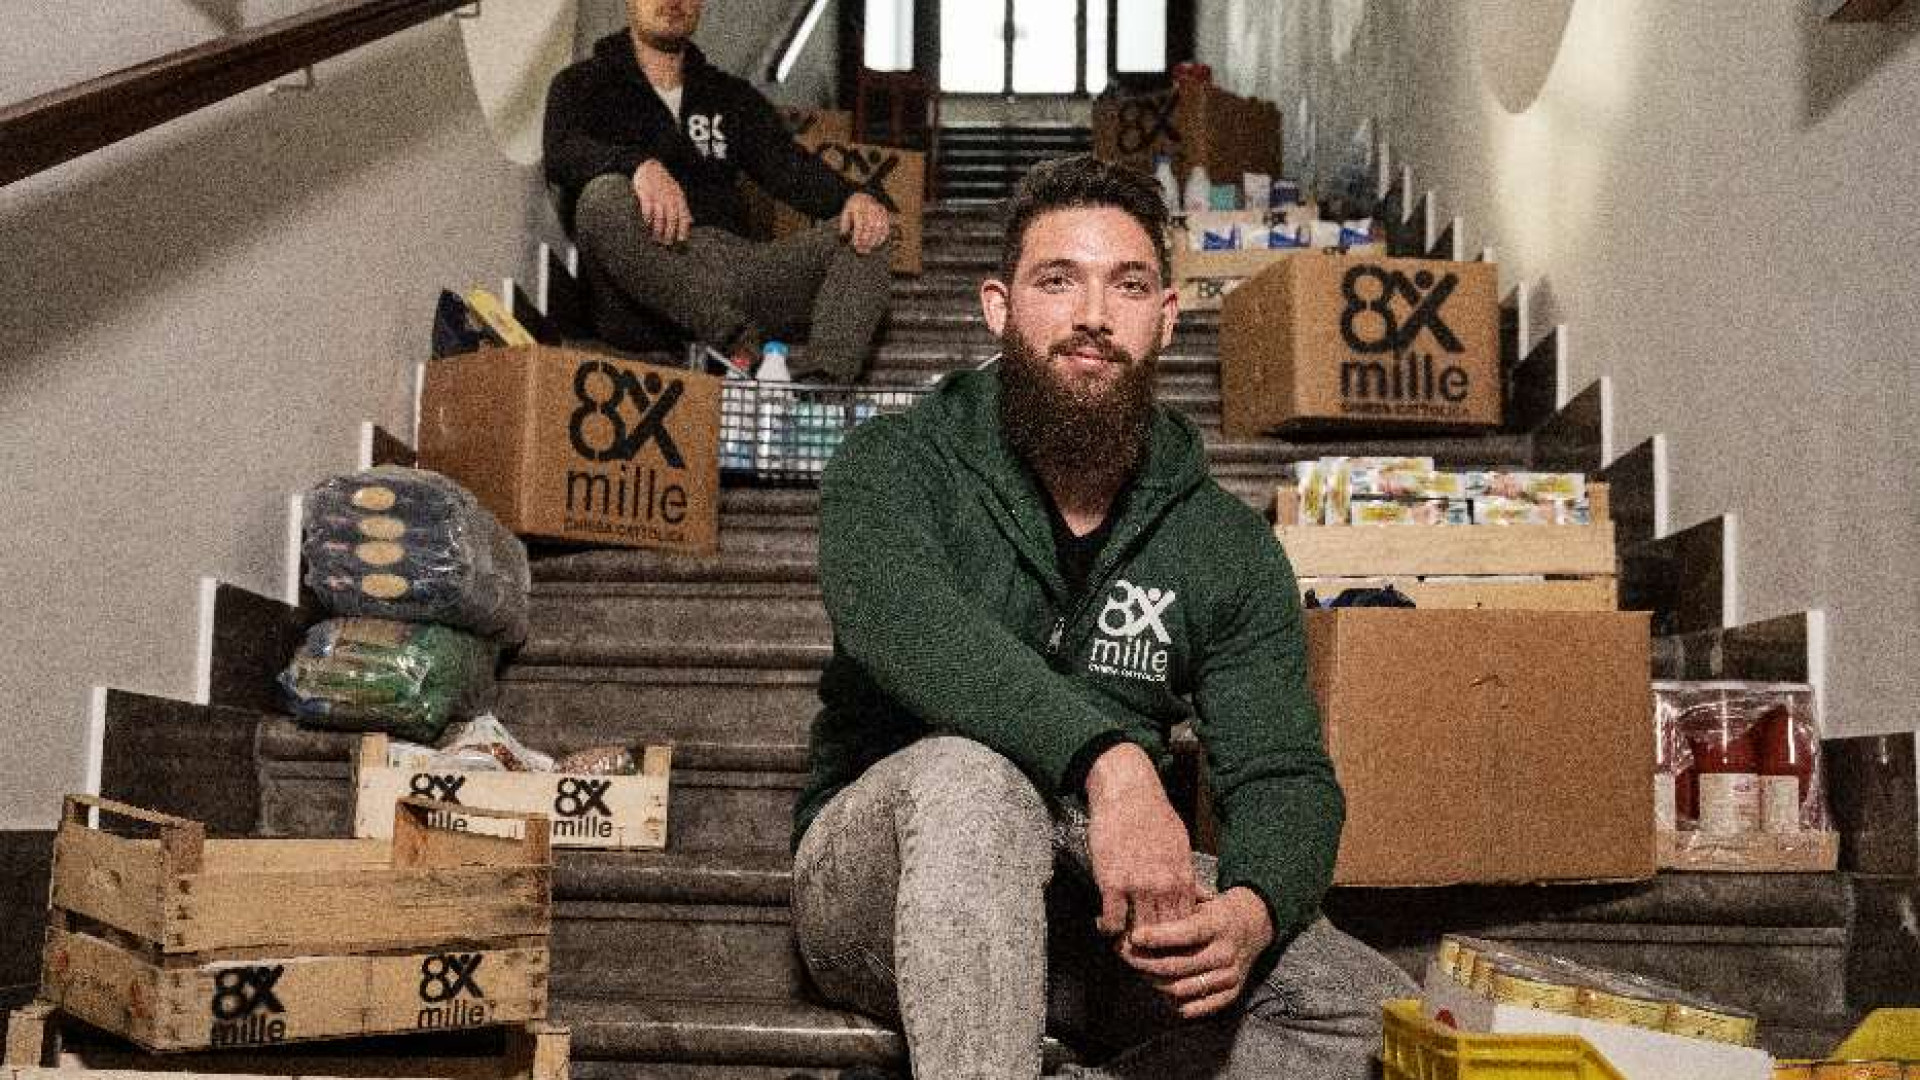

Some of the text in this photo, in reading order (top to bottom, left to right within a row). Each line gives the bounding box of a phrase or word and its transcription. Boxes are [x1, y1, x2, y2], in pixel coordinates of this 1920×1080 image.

[1340, 264, 1465, 353] 8X
[1340, 351, 1469, 401] mille
[569, 360, 685, 468] 8X
[566, 464, 687, 524] mille
[1098, 579, 1176, 644] 8X
[1089, 637, 1168, 672] mille
[554, 777, 612, 817] 8X
[553, 816, 612, 838] mille
[211, 964, 286, 1019] 8X
[420, 953, 485, 1002] 8X
[211, 1012, 286, 1046] mille
[417, 998, 485, 1029] mille
